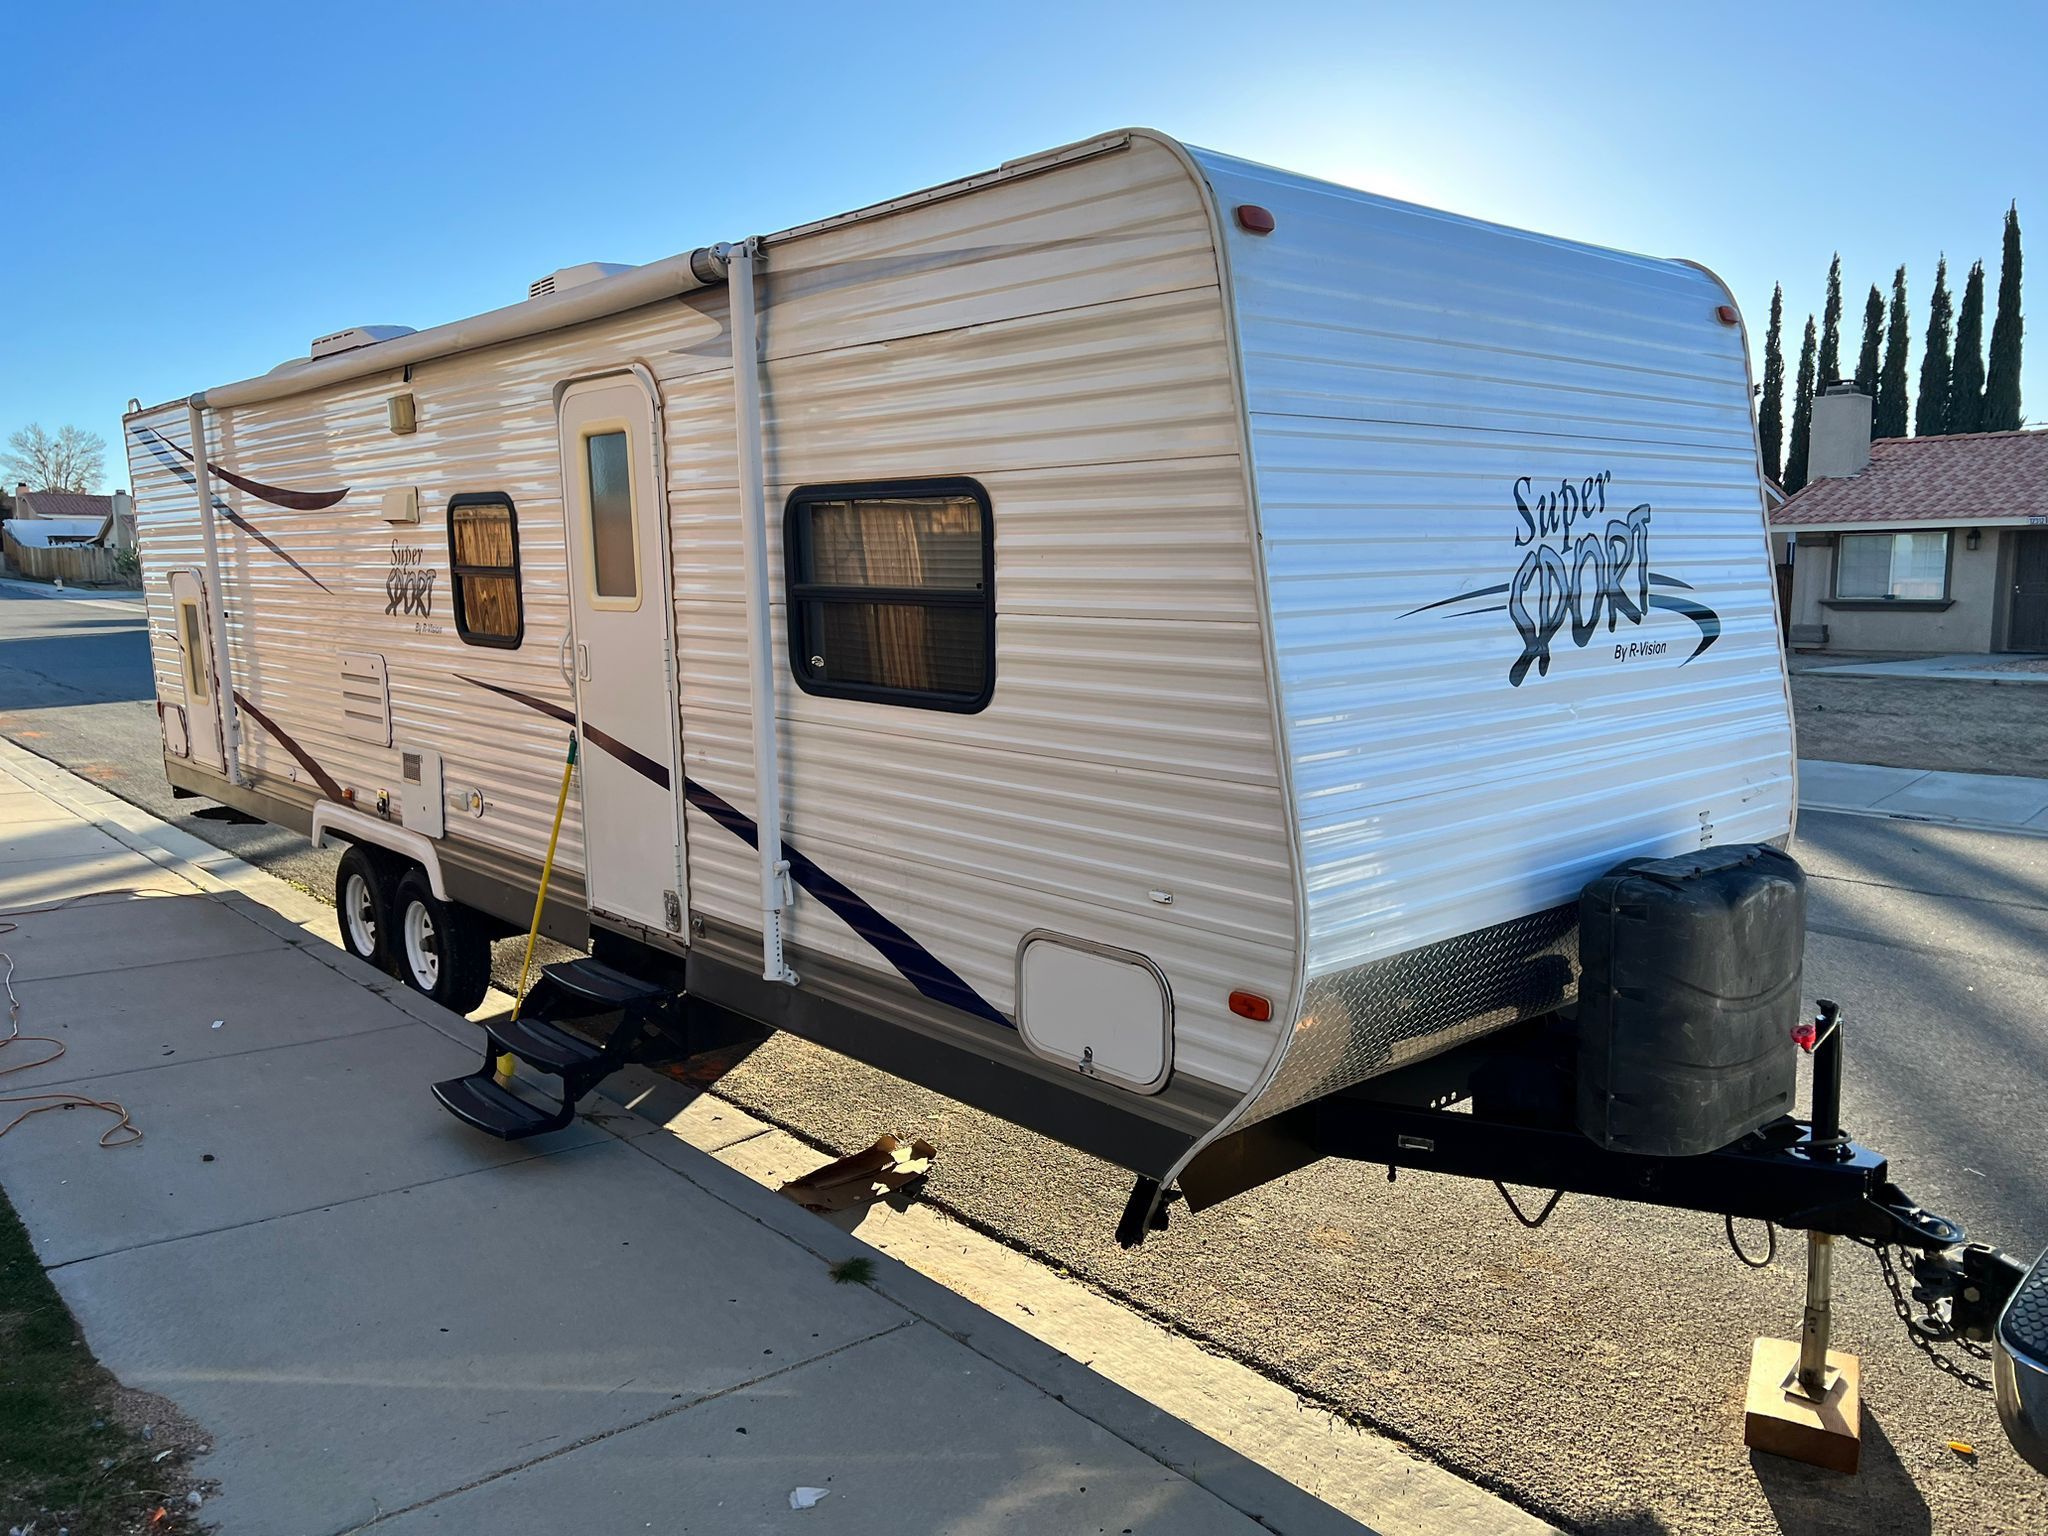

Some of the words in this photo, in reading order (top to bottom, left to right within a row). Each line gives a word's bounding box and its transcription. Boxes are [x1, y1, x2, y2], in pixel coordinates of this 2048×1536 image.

[1513, 470, 1611, 554] Super
[391, 538, 424, 575] Super
[385, 567, 437, 619] SPORT
[1509, 503, 1651, 687] SPORT
[1614, 644, 1628, 662] By
[1629, 640, 1667, 657] R-Vision
